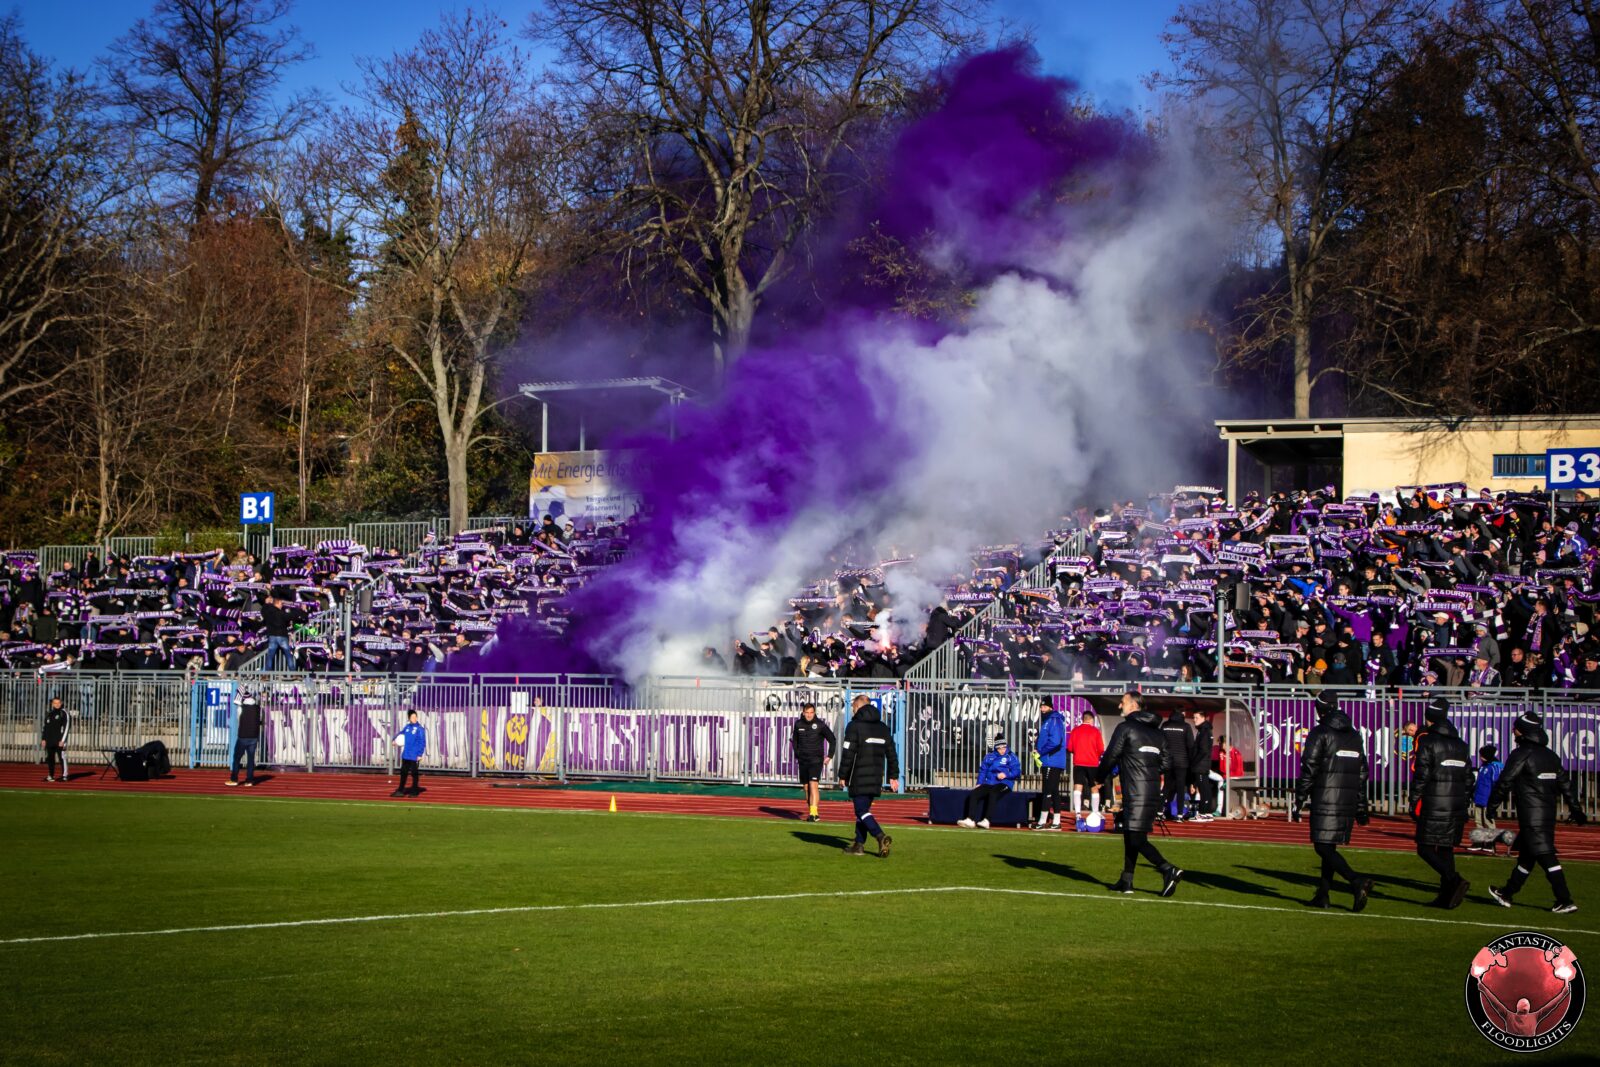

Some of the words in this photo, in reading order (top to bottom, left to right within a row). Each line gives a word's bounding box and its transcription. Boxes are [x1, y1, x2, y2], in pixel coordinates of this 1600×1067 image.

[530, 462, 554, 479] Mit
[557, 460, 604, 482] Energie
[1550, 453, 1600, 483] B3
[242, 495, 271, 519] B1
[211, 689, 216, 704] 1
[270, 708, 352, 767] WIR
[367, 709, 469, 769] SND
